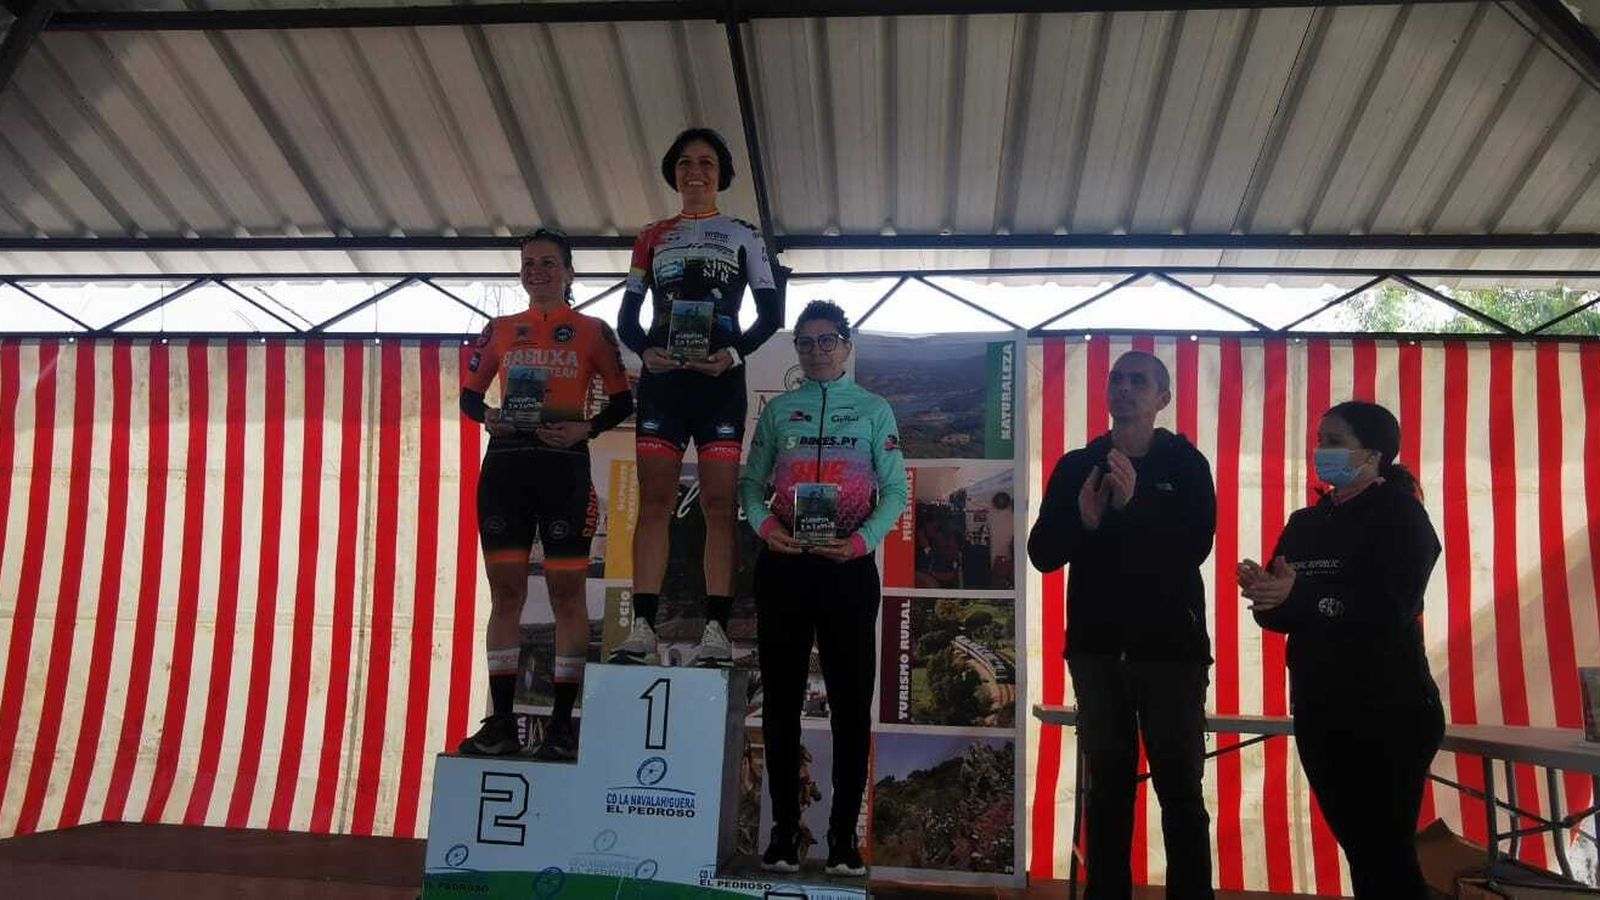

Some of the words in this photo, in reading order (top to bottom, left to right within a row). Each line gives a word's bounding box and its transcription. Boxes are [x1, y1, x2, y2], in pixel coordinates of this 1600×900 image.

[1001, 344, 1014, 440] NATURALEZA
[619, 591, 631, 627] OCIO
[899, 599, 911, 650] RURAL
[898, 653, 910, 720] TURISMO
[640, 678, 671, 750] 1
[477, 771, 530, 847] 2
[606, 804, 624, 813] EL
[628, 805, 695, 818] PEDROSO
[630, 794, 695, 809] NAVALAHIGUERA
[700, 878, 714, 886] EL
[717, 879, 772, 891] PEDROSO
